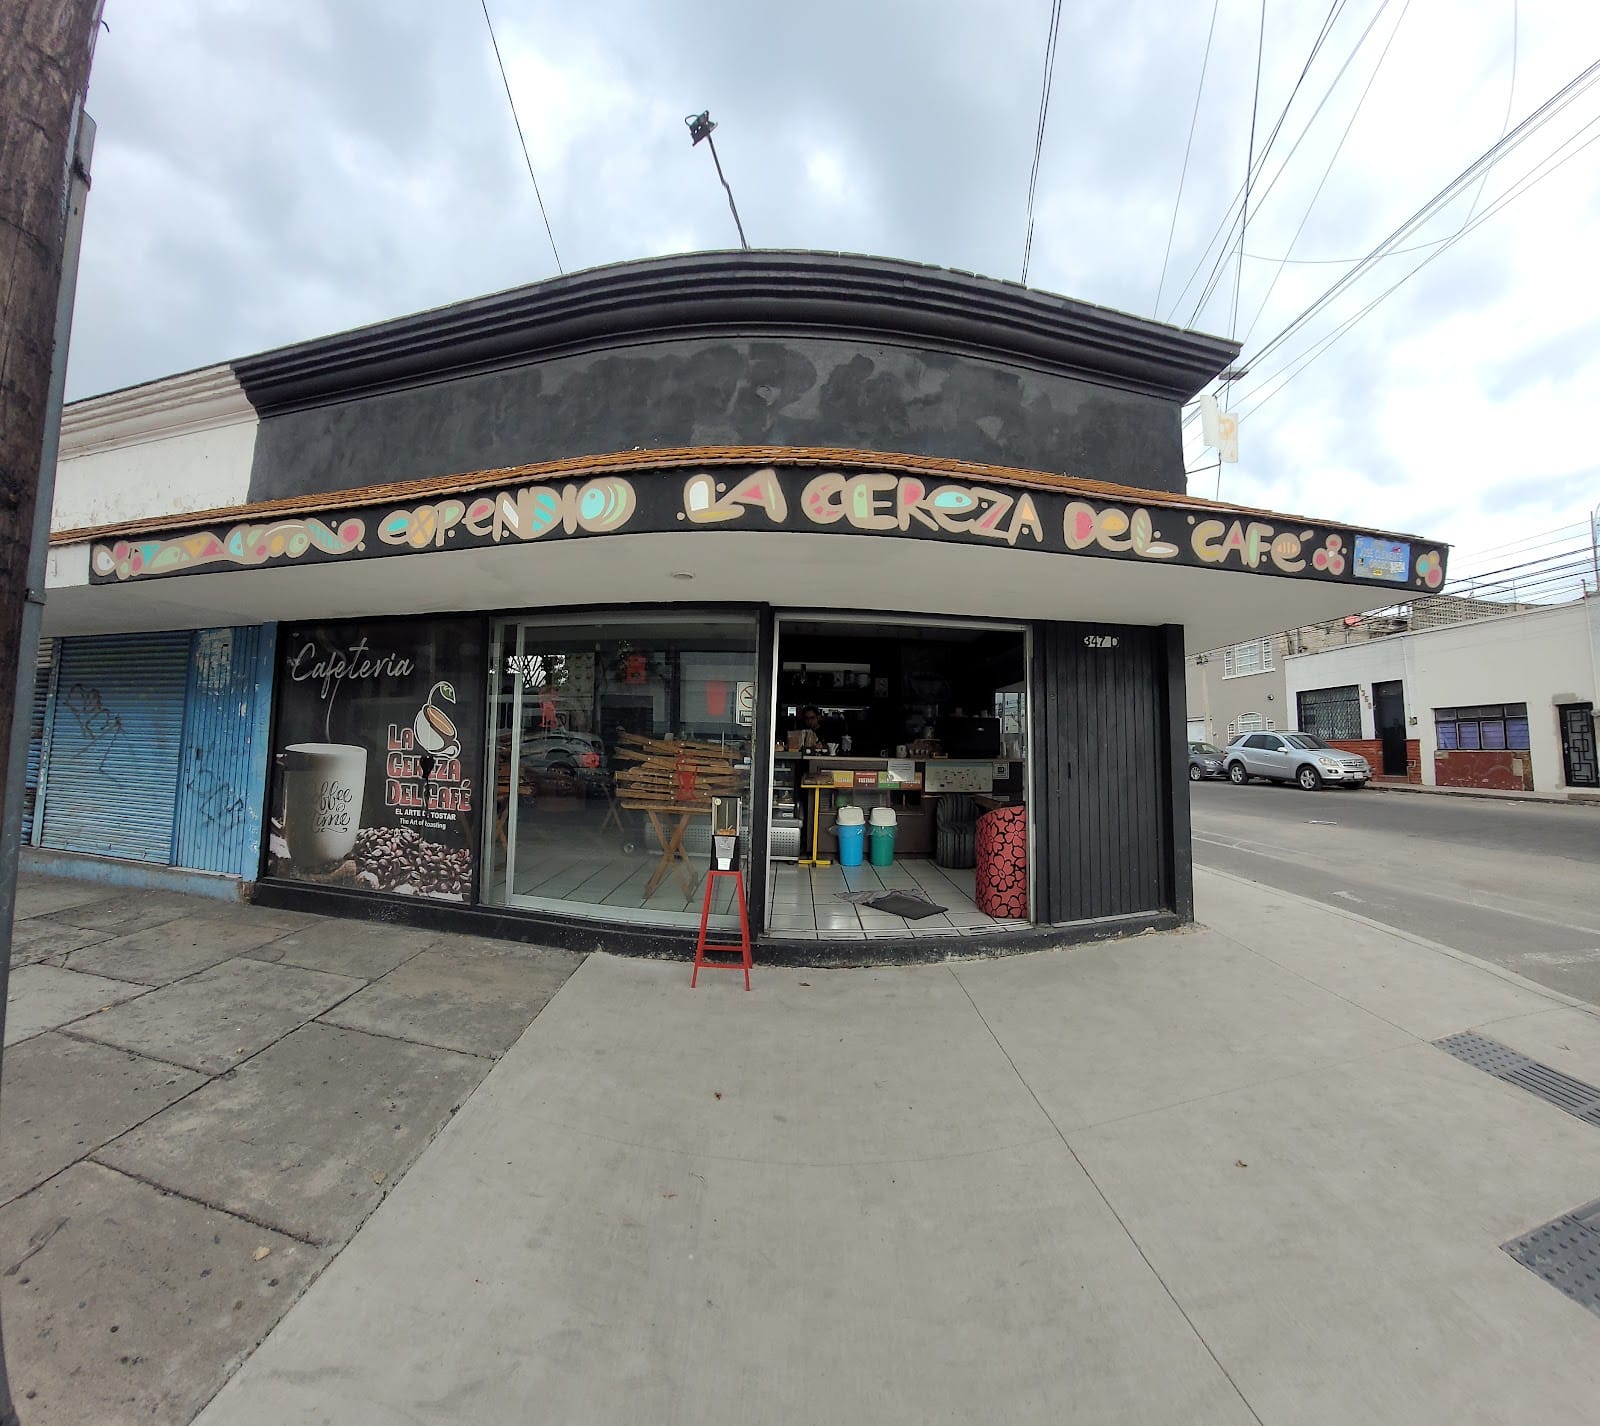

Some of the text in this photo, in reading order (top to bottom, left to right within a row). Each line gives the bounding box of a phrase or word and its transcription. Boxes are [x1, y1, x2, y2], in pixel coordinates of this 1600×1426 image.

[684, 469, 787, 523] LA
[292, 637, 414, 699] Cafeteria
[387, 724, 414, 750] LA
[386, 779, 422, 806] DEL
[410, 818, 418, 826] Art
[431, 812, 456, 821] TOSTAR
